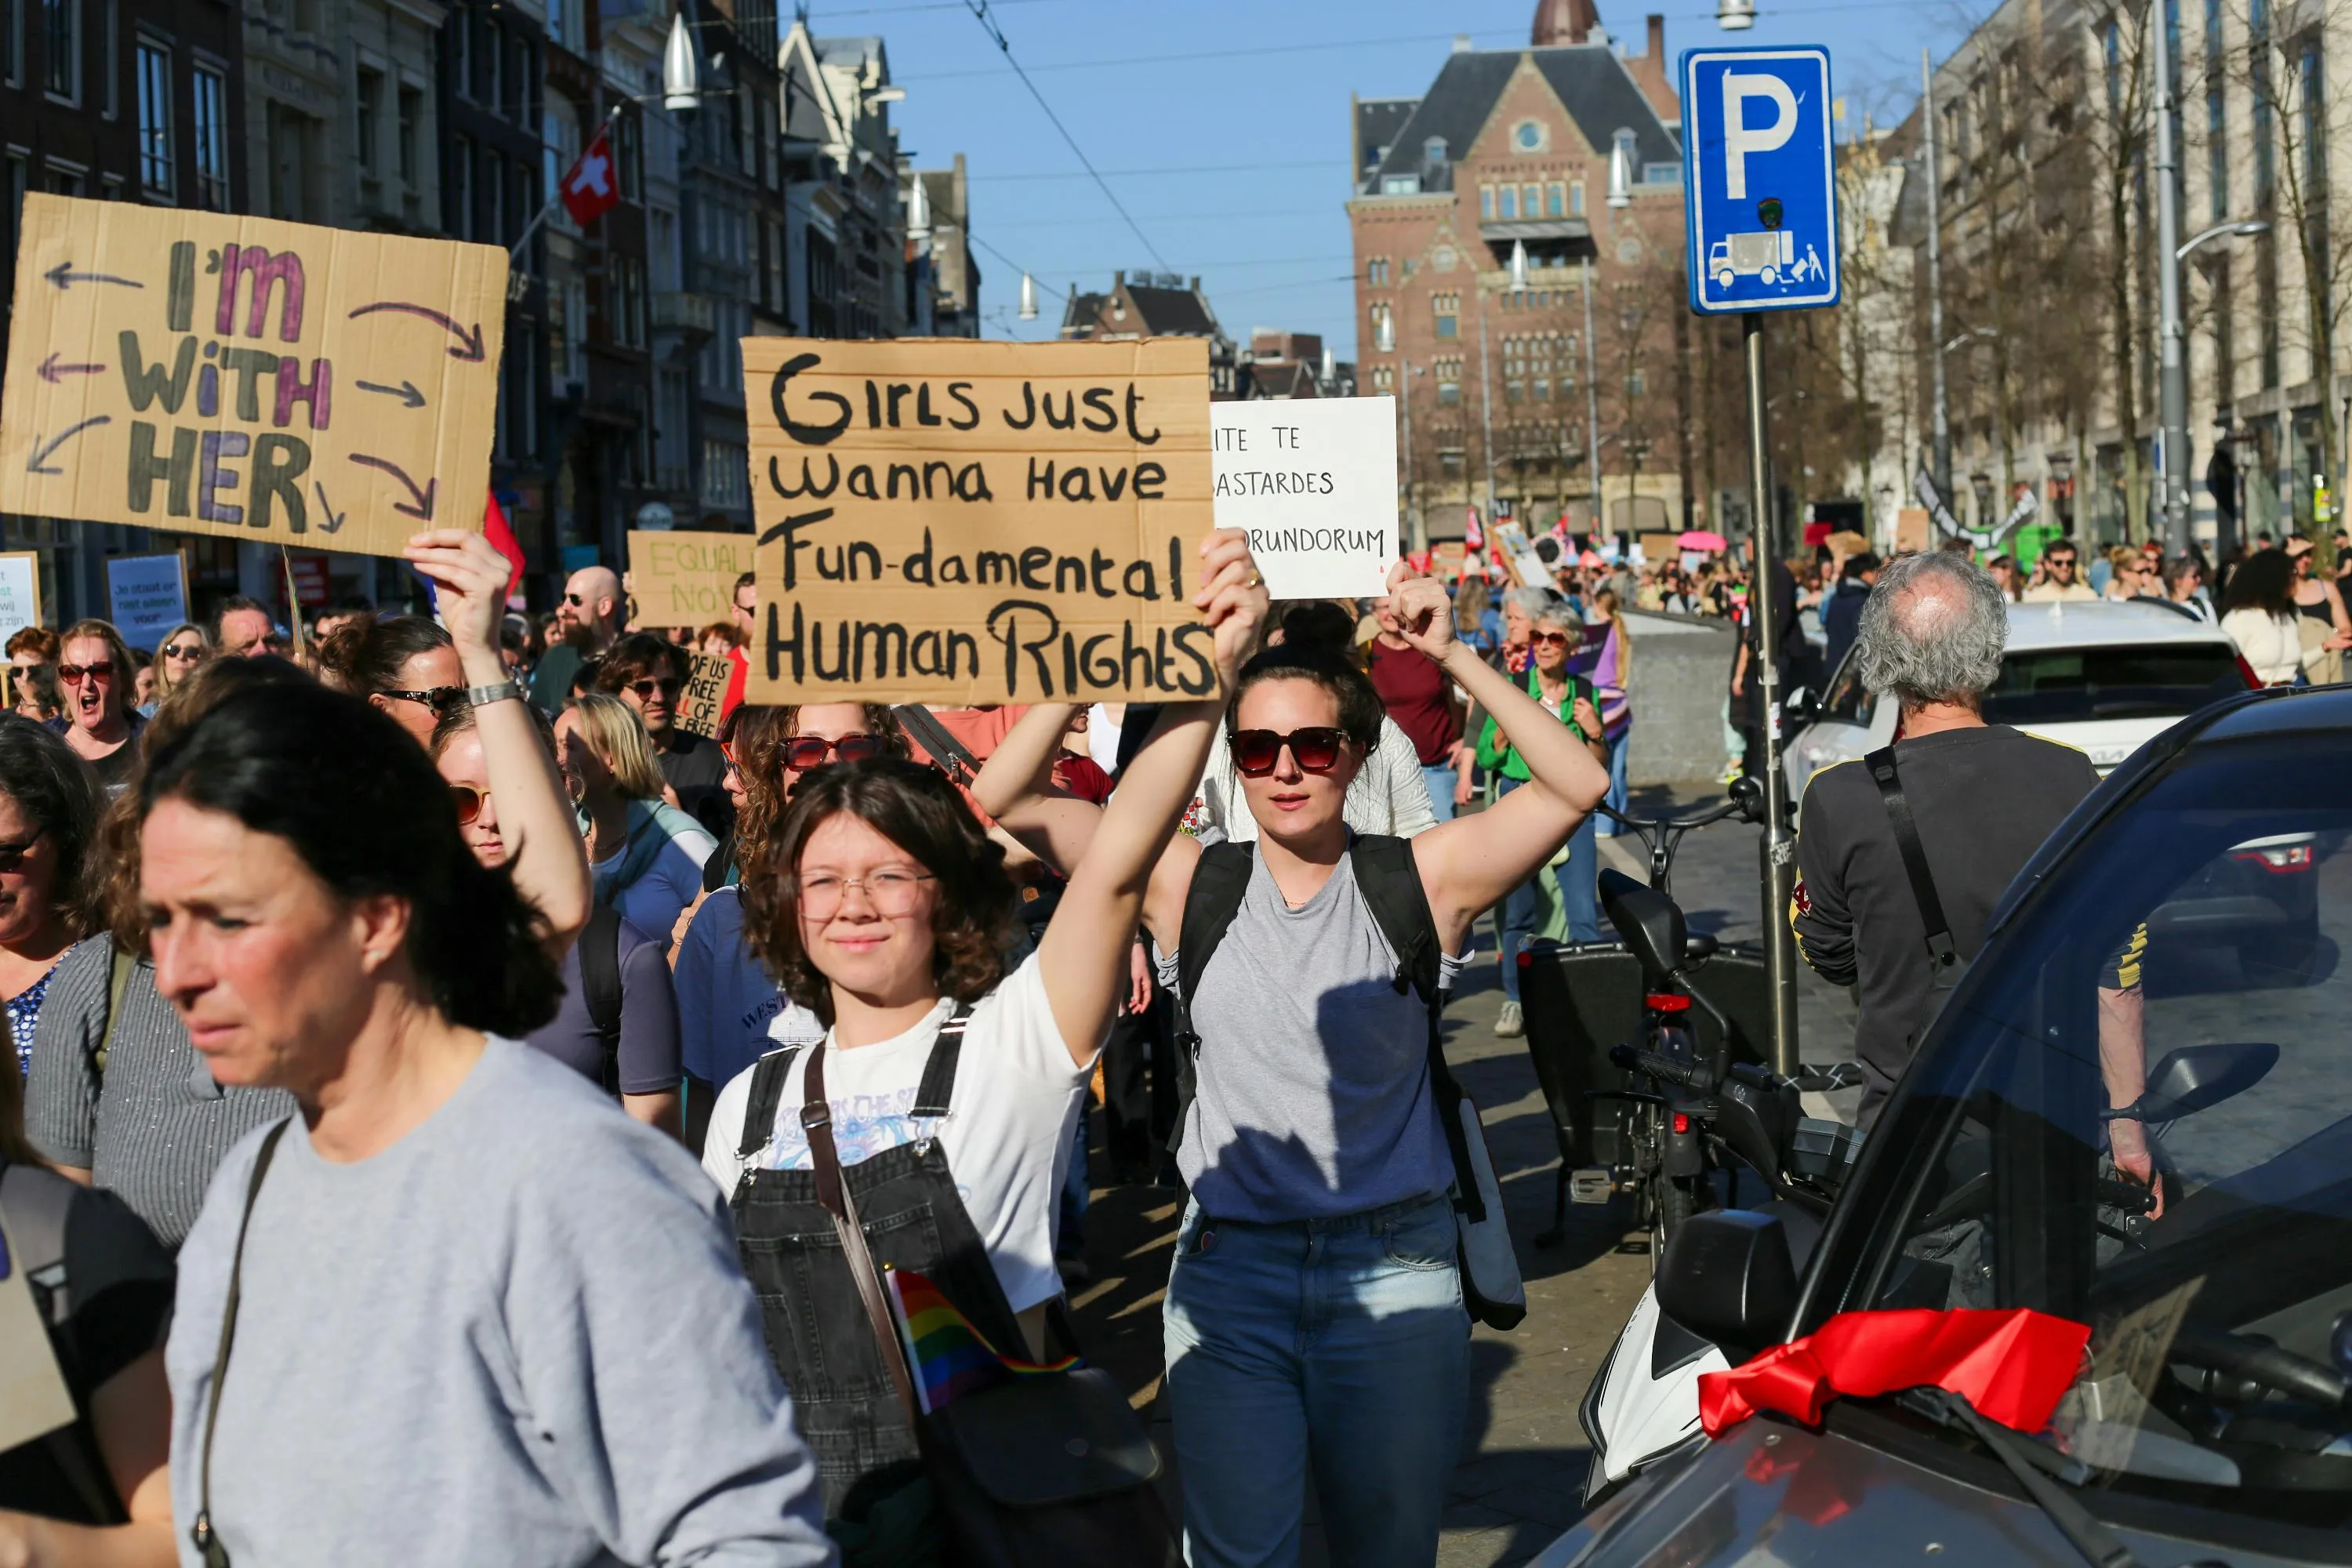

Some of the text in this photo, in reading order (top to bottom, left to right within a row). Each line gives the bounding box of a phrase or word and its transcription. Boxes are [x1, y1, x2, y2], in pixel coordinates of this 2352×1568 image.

[1722, 73, 1798, 199] P
[1211, 426, 1300, 452] ITE TE
[128, 420, 311, 534] HER
[1213, 472, 1334, 497] ASTARDES
[650, 542, 754, 576] EQUALI
[710, 659, 729, 680] US
[688, 677, 720, 702] REE
[676, 698, 691, 717] LL
[694, 702, 717, 720] OF
